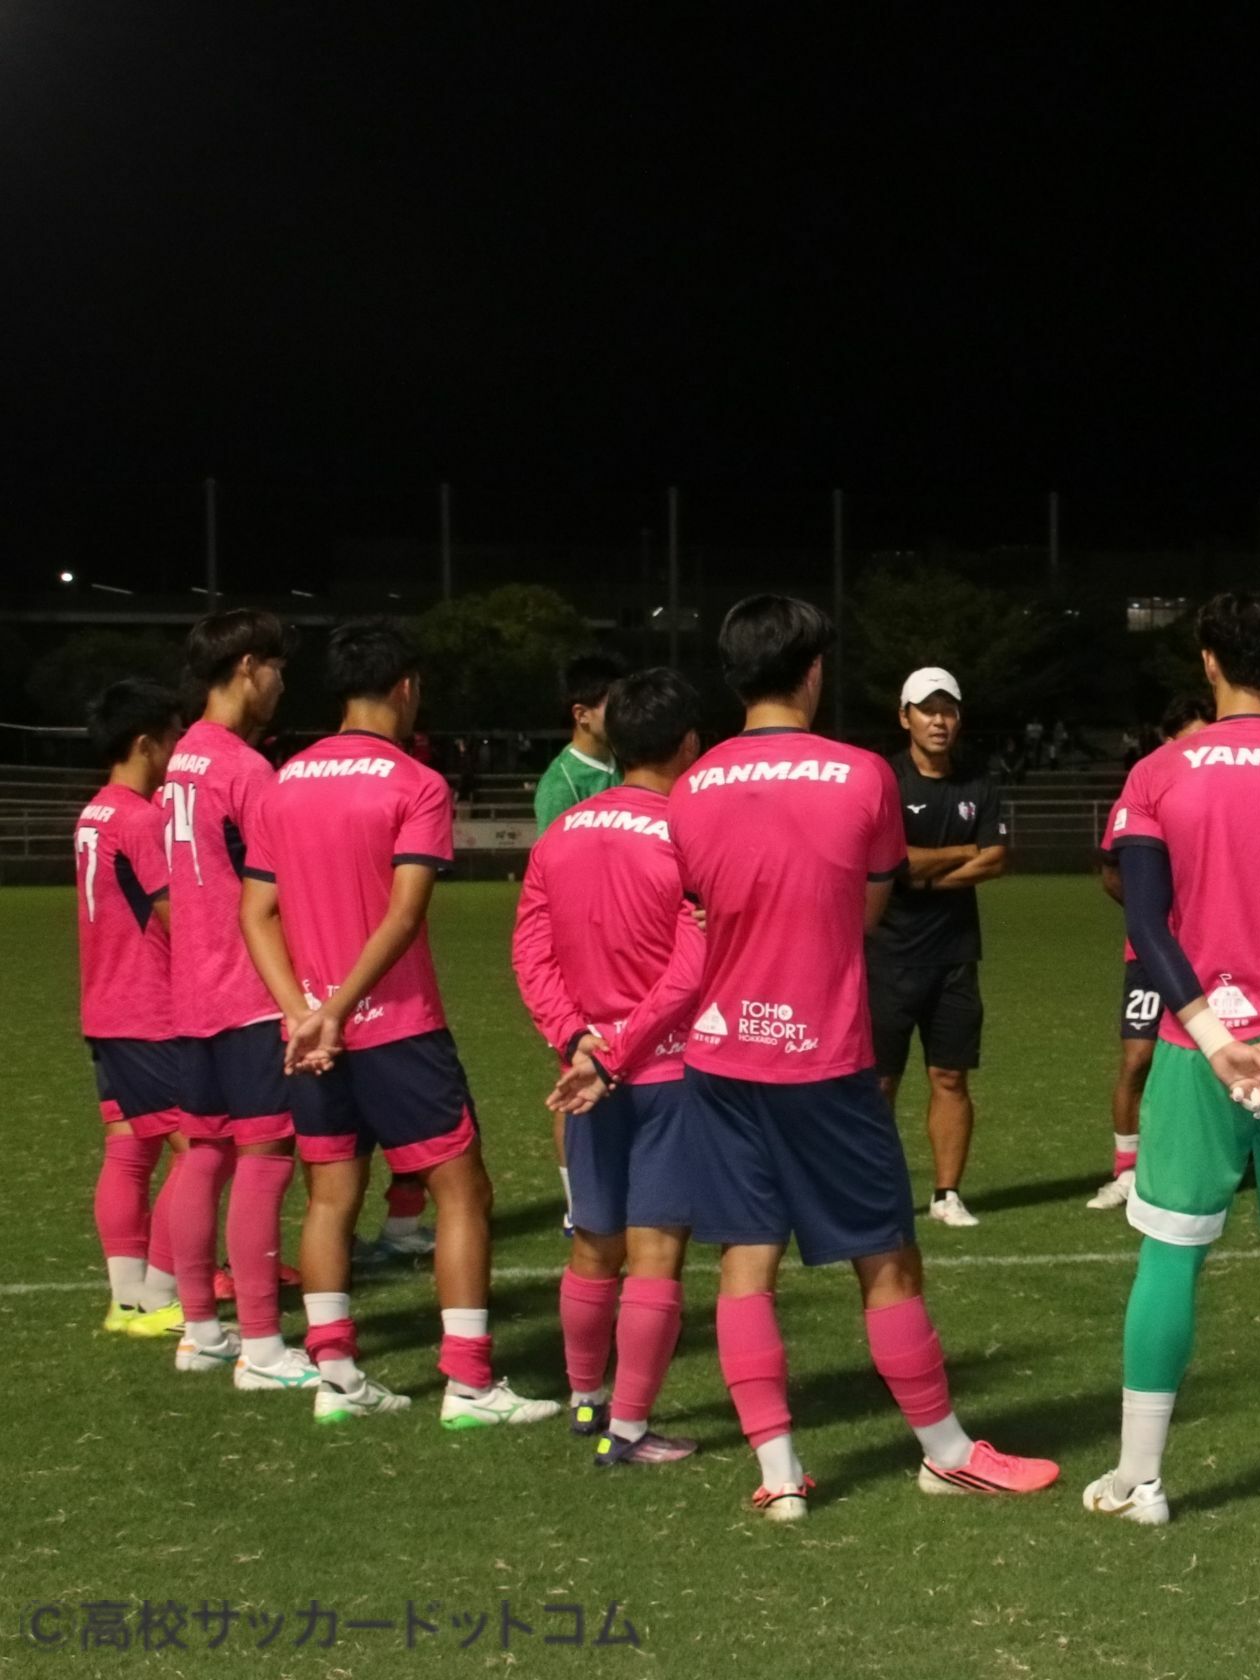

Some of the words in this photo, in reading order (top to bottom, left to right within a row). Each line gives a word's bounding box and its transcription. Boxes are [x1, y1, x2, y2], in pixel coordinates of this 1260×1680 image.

[278, 757, 396, 784] YANMAR
[688, 760, 850, 794] YANMAR
[562, 810, 672, 842] YANMA
[741, 1000, 793, 1021] TOHO
[1125, 989, 1160, 1020] 20
[739, 1018, 807, 1040] RESORT
